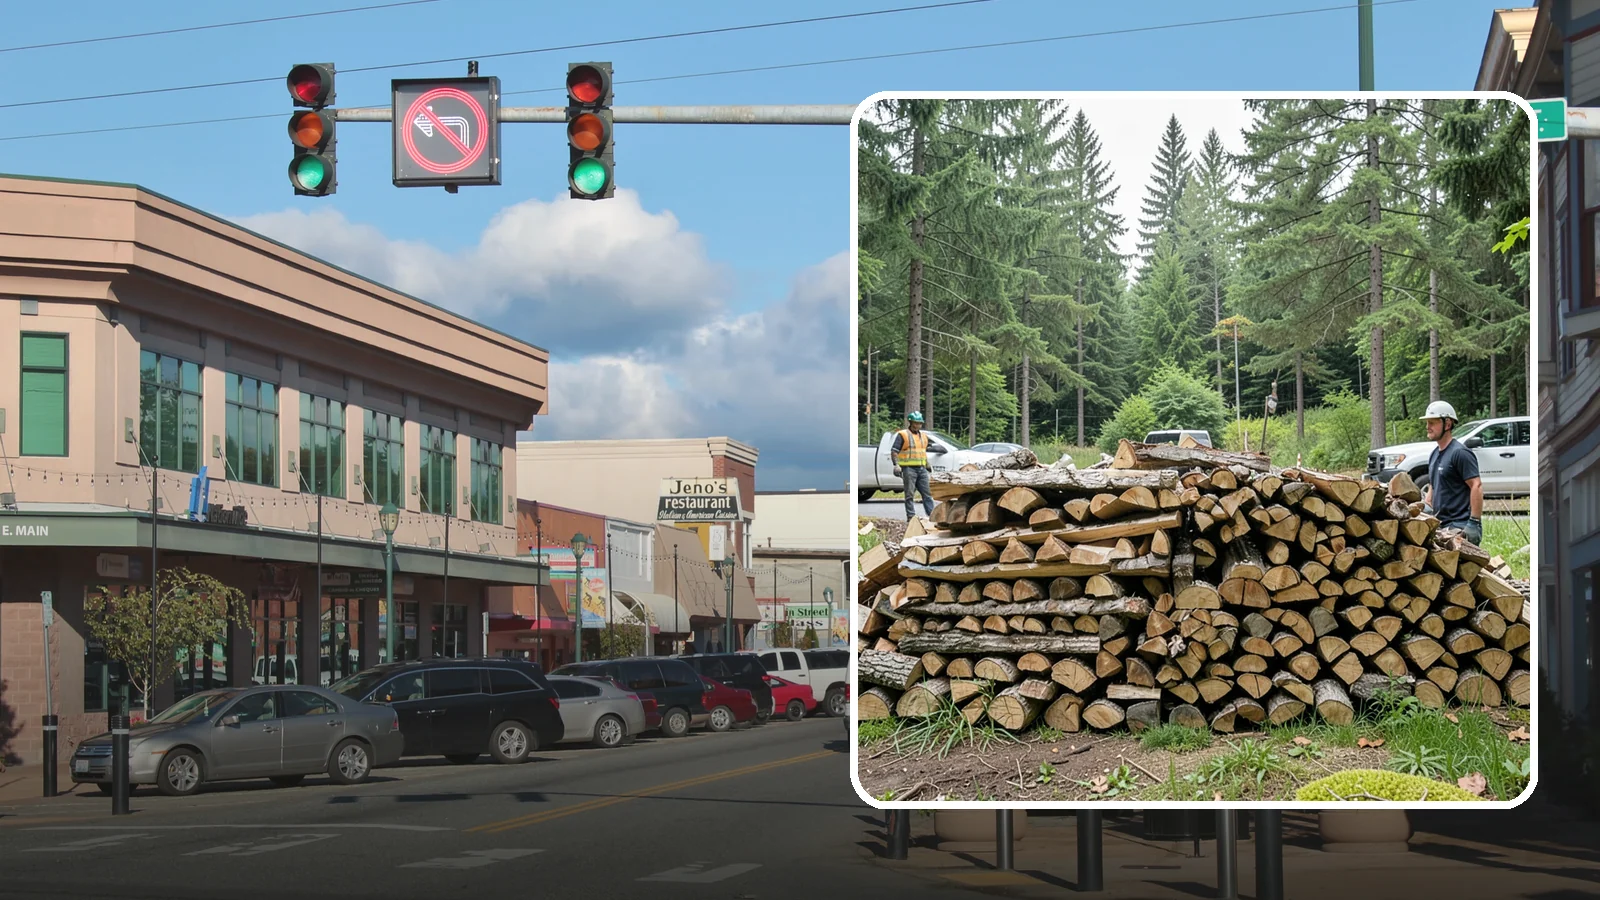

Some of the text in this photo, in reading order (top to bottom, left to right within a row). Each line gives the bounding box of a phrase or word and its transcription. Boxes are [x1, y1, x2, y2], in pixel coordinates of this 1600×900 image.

[670, 480, 727, 495] Jeno's
[665, 496, 731, 509] restaurant
[659, 510, 682, 520] Italian
[686, 510, 715, 519] American
[715, 510, 737, 519] Cuisine
[2, 525, 49, 536] E. MAIN
[797, 608, 828, 617] Street
[791, 619, 823, 627] lass
